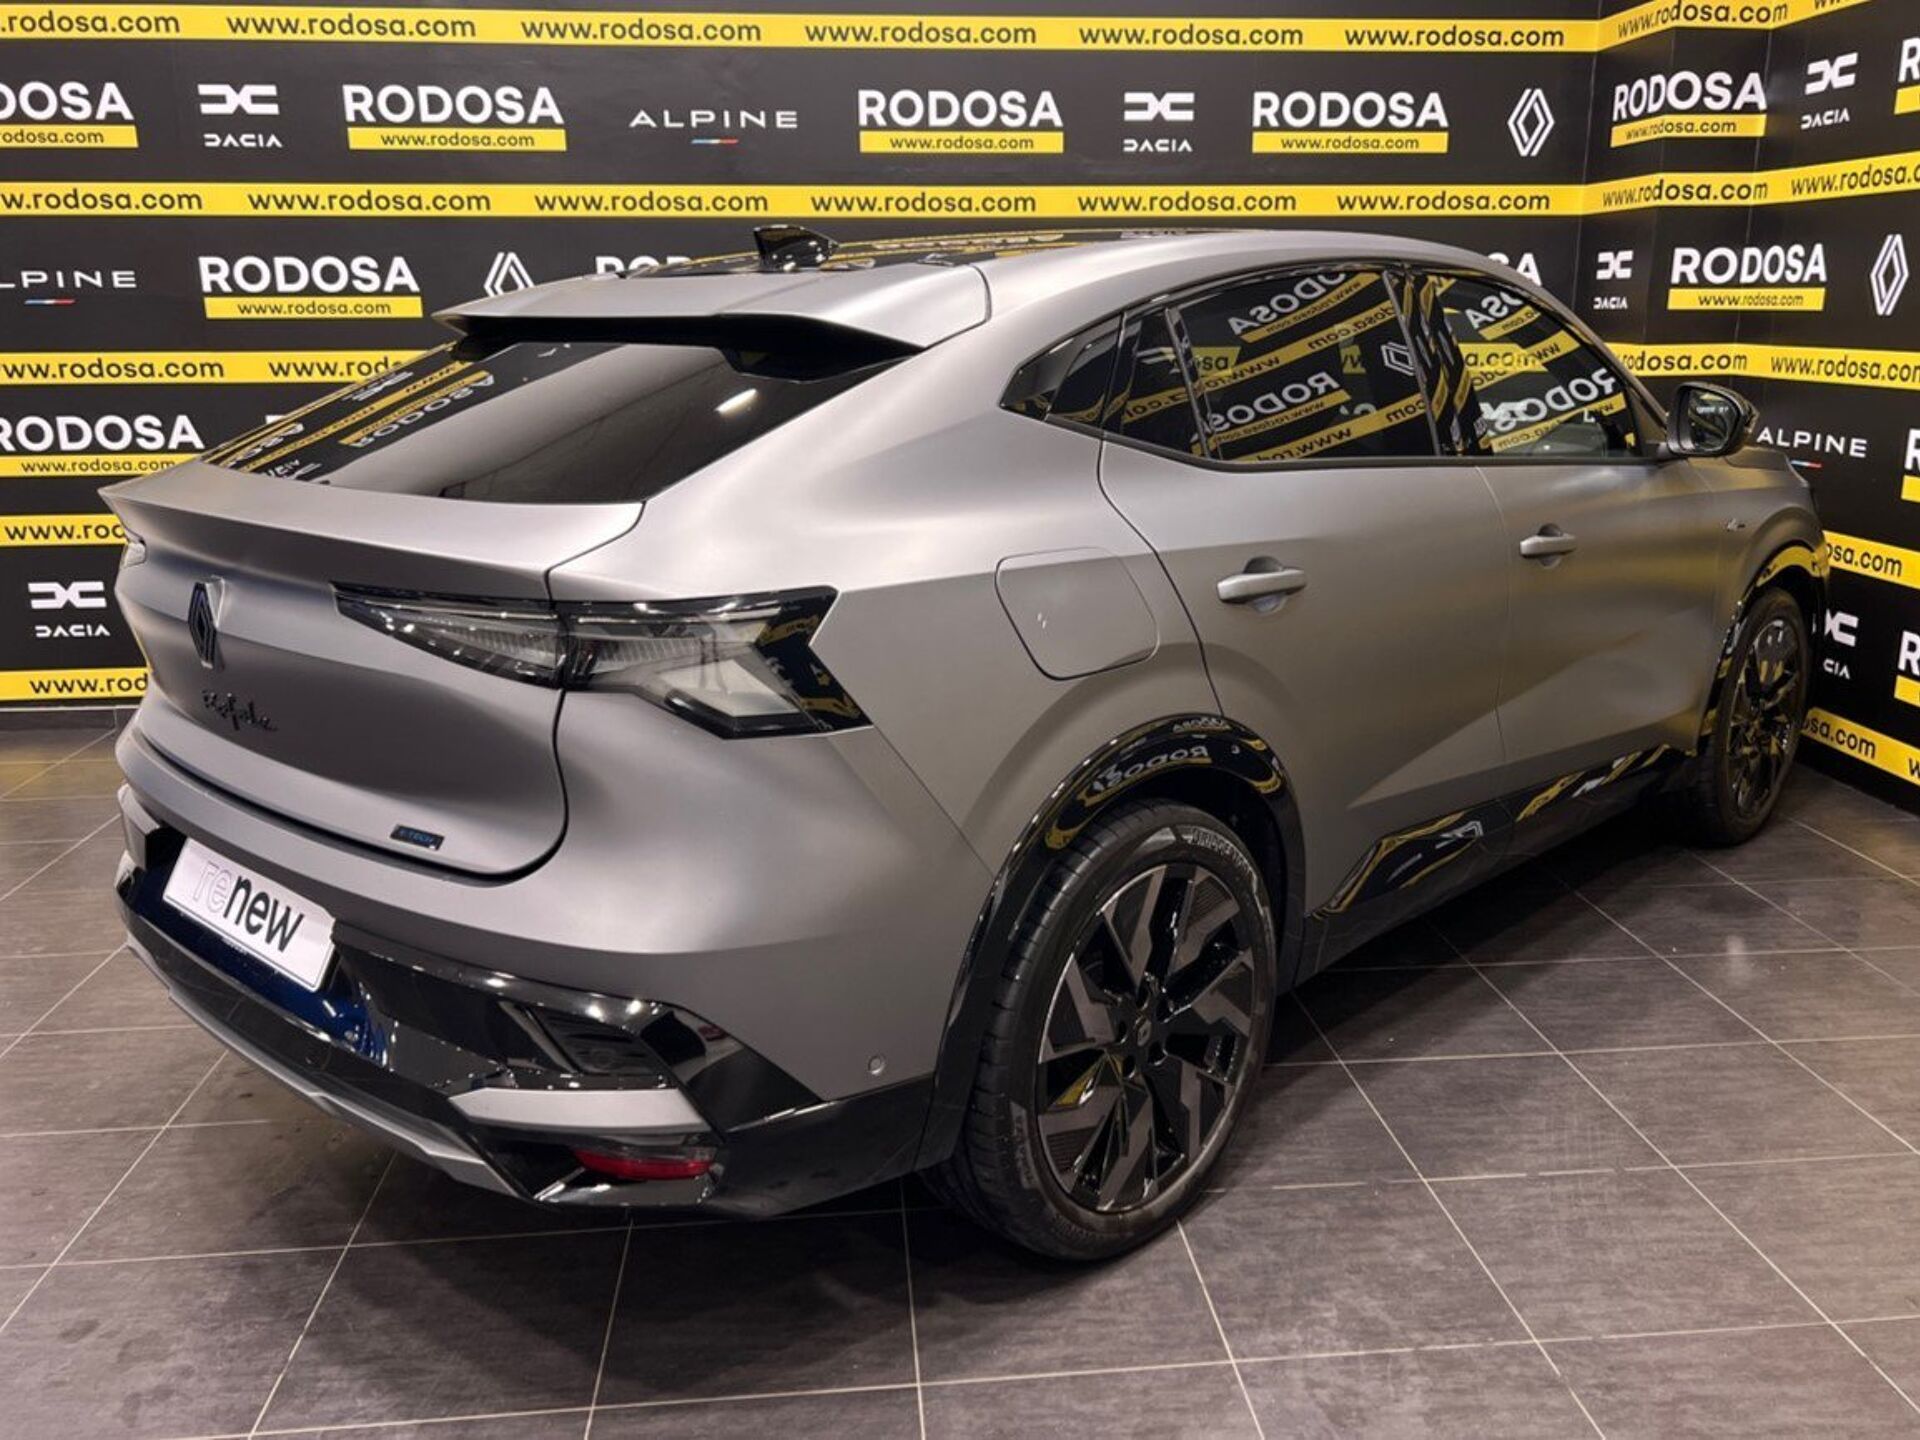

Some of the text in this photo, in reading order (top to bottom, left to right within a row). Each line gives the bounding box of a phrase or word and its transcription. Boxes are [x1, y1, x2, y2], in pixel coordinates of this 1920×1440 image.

[226, 14, 478, 38] www.rodosa.com
[520, 18, 763, 41] www.rodosa.com
[1617, 0, 1788, 38] www.rodosa.com
[804, 20, 1037, 44] www.rodosa.com
[1079, 23, 1304, 46] www.rodosa.com
[1344, 24, 1565, 47] www.rodosa.com
[342, 84, 564, 125] RODOSA
[1612, 70, 1768, 122] RODOSA
[629, 109, 798, 129] ALPINE
[857, 89, 1064, 129] RODOSA
[1252, 91, 1449, 128] RODOSA
[1801, 107, 1850, 130] DACIA
[203, 133, 283, 148] DACIA
[380, 131, 535, 147] www.rodosa.com
[1625, 120, 1737, 140] www.rodosa.com
[889, 135, 1034, 150] www.rodosa.com
[1123, 138, 1192, 153] DACIA
[1280, 135, 1420, 150] www.rodosa.com
[247, 189, 491, 211] www.rodosa.com
[534, 190, 768, 212] www.rodosa.com
[810, 191, 1036, 213] www.rodosa.com
[1077, 190, 1297, 212] www.rodosa.com
[1336, 190, 1550, 211] www.rodosa.com
[1602, 178, 1769, 208] www.rodosa.com
[198, 255, 420, 293] RODOSA
[1670, 243, 1827, 284] RODOSA
[1593, 297, 1628, 310] DACIA
[1697, 293, 1804, 307] www.rodosa.com
[237, 304, 392, 319] www.rodosa.com
[0, 357, 226, 379] ww.rodosa.com
[1757, 427, 1868, 458] ALPINE
[34, 624, 110, 638] DACIA
[193, 858, 305, 953] renew
